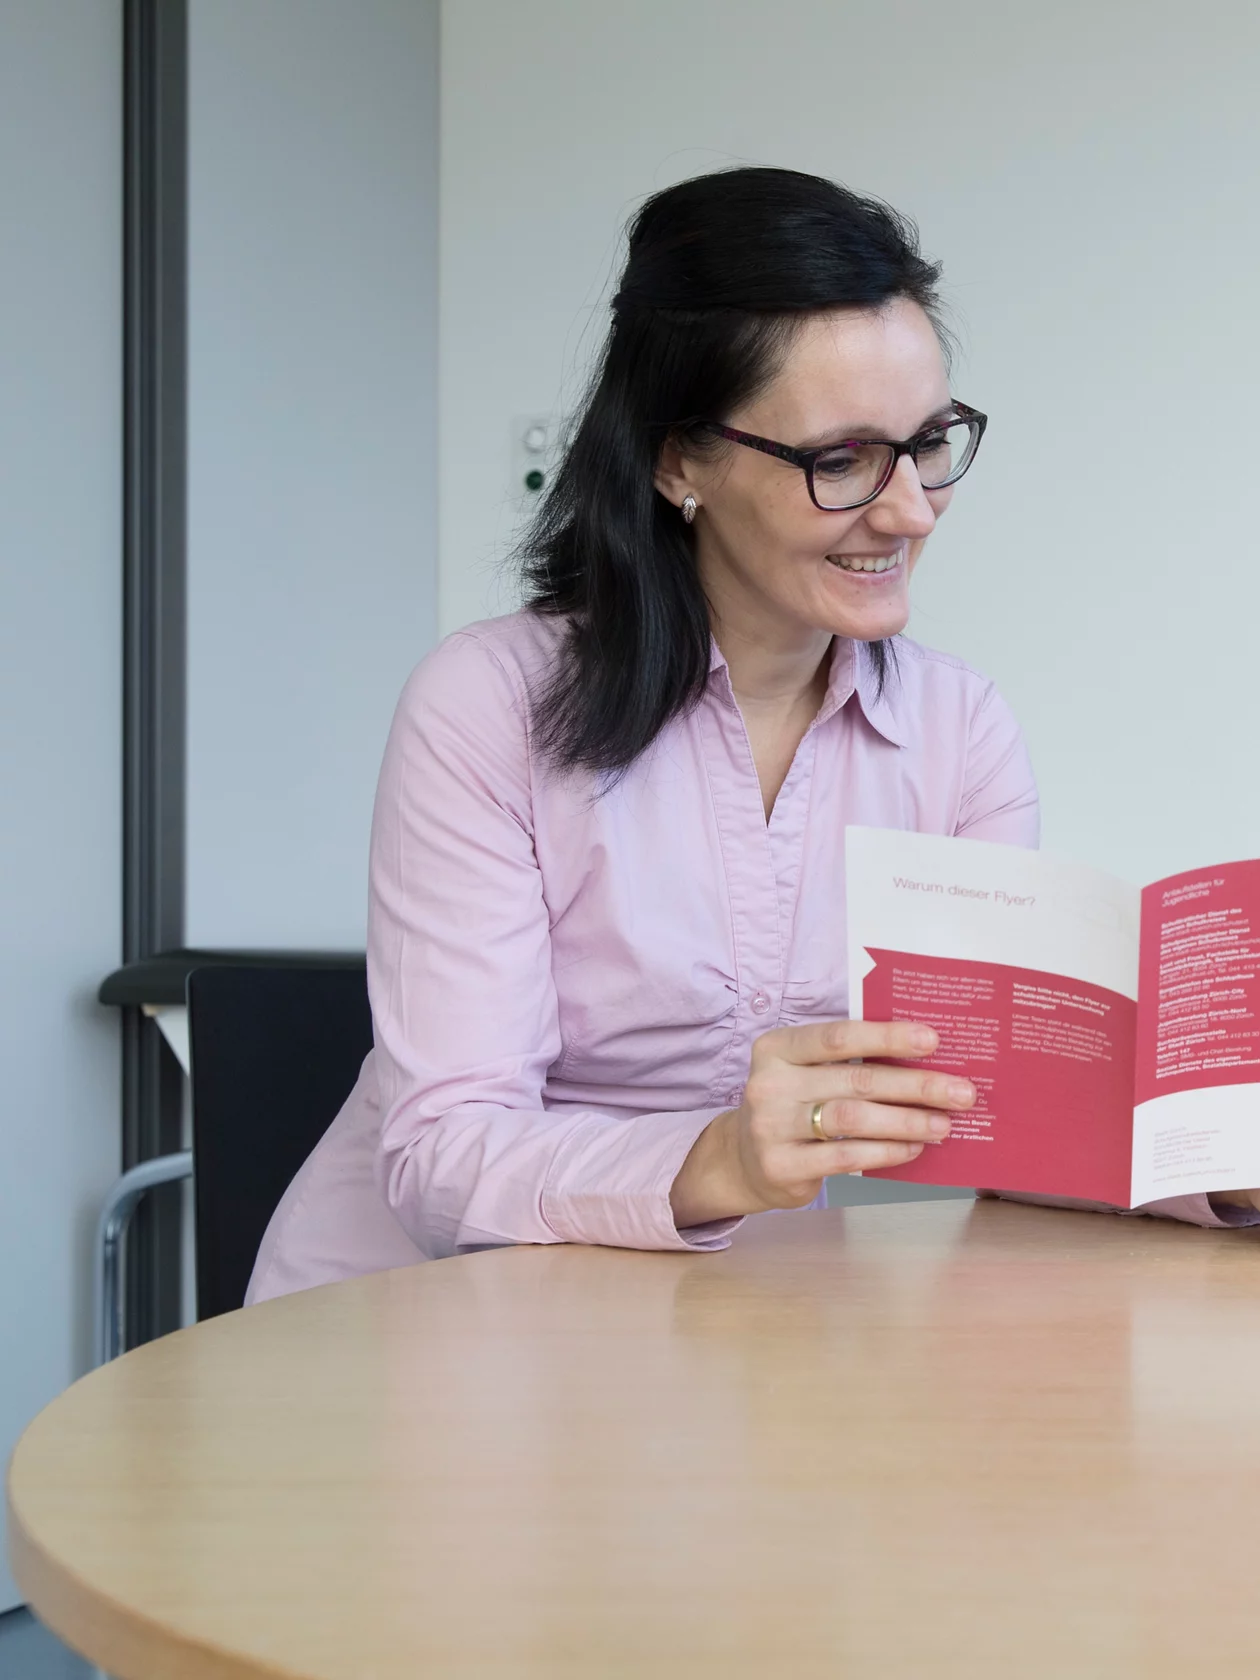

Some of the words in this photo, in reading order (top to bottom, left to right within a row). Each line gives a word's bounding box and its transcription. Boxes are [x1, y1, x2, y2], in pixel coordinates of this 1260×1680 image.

[892, 876, 944, 894] Warum
[948, 884, 991, 901] dieser
[994, 891, 1036, 907] Flyer?
